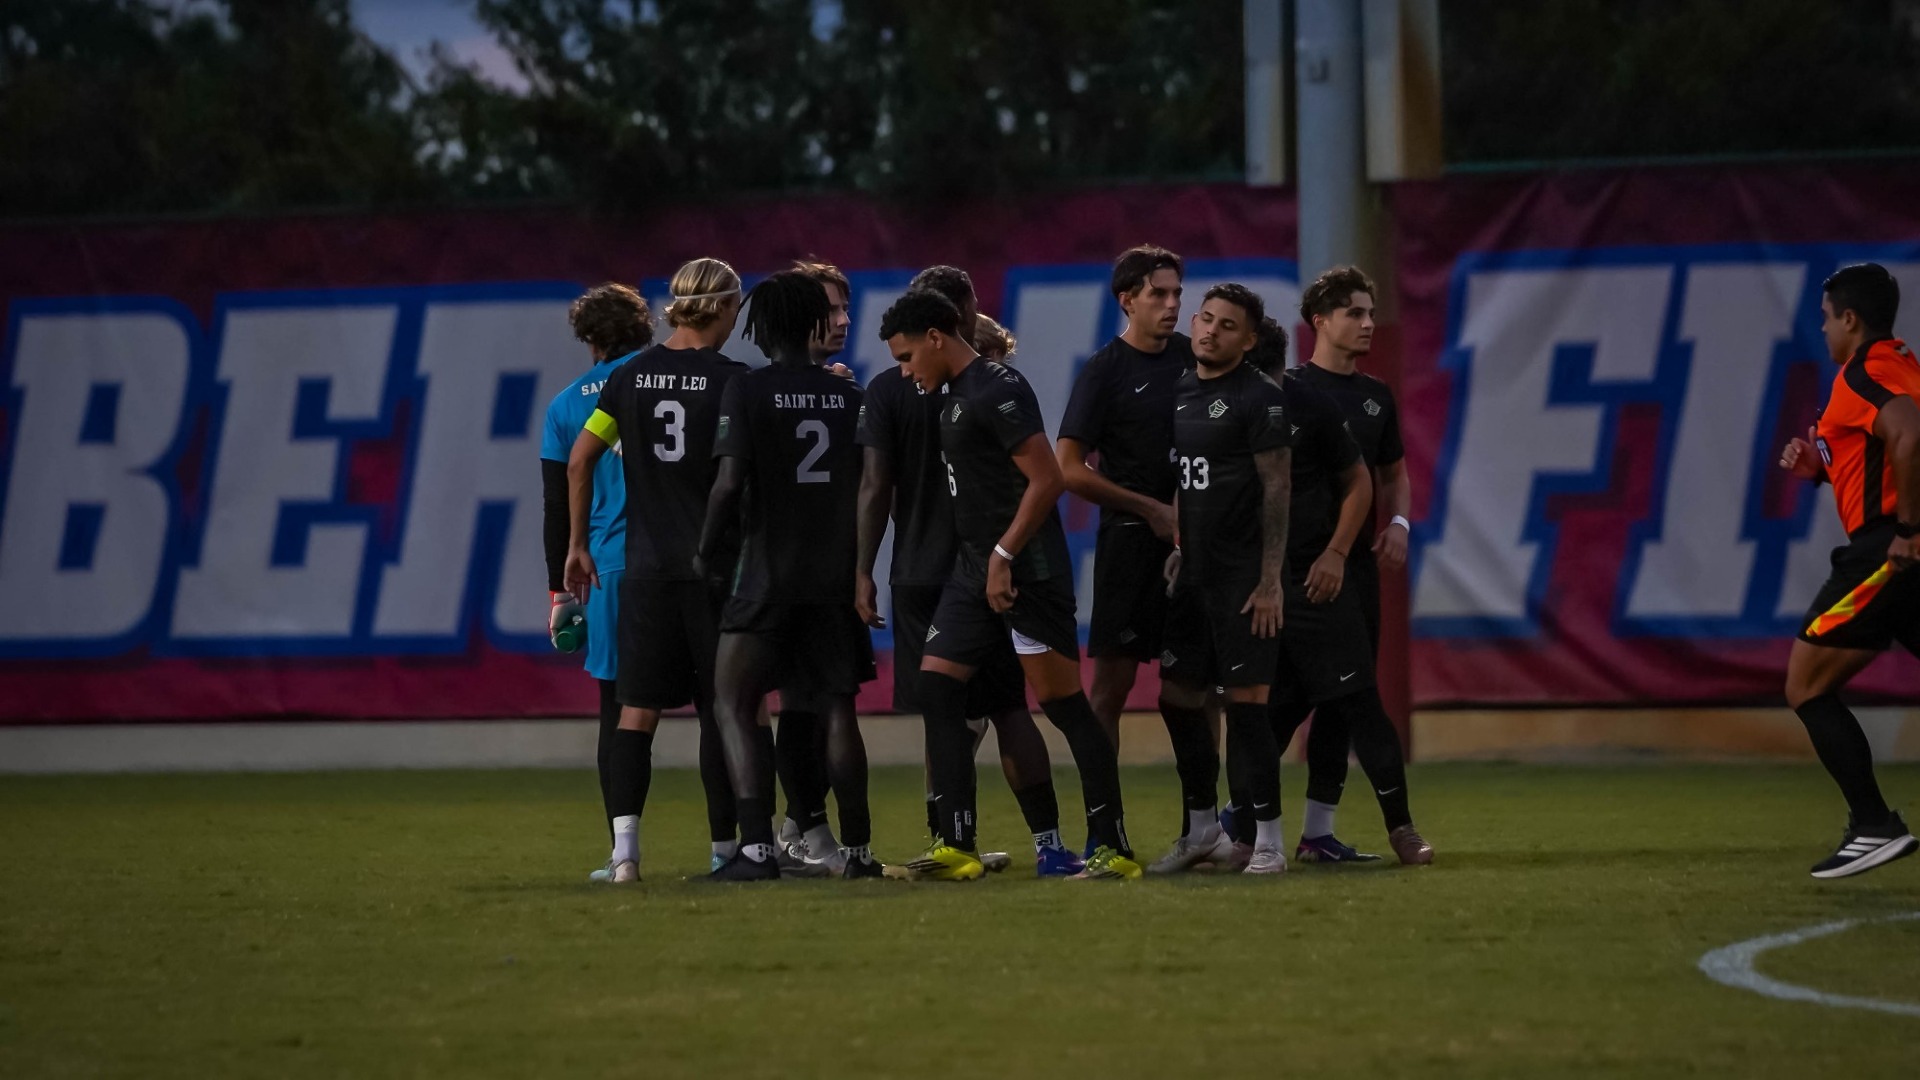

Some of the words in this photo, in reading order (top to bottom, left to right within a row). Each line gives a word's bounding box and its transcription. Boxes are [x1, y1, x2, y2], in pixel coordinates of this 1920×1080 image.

[635, 373, 677, 391] SAINT
[681, 375, 707, 391] LEO
[774, 393, 816, 409] SAINT
[821, 393, 845, 410] LEO
[653, 400, 685, 463] 3
[795, 419, 831, 484] 2
[947, 463, 958, 497] 6
[1179, 456, 1210, 491] 33
